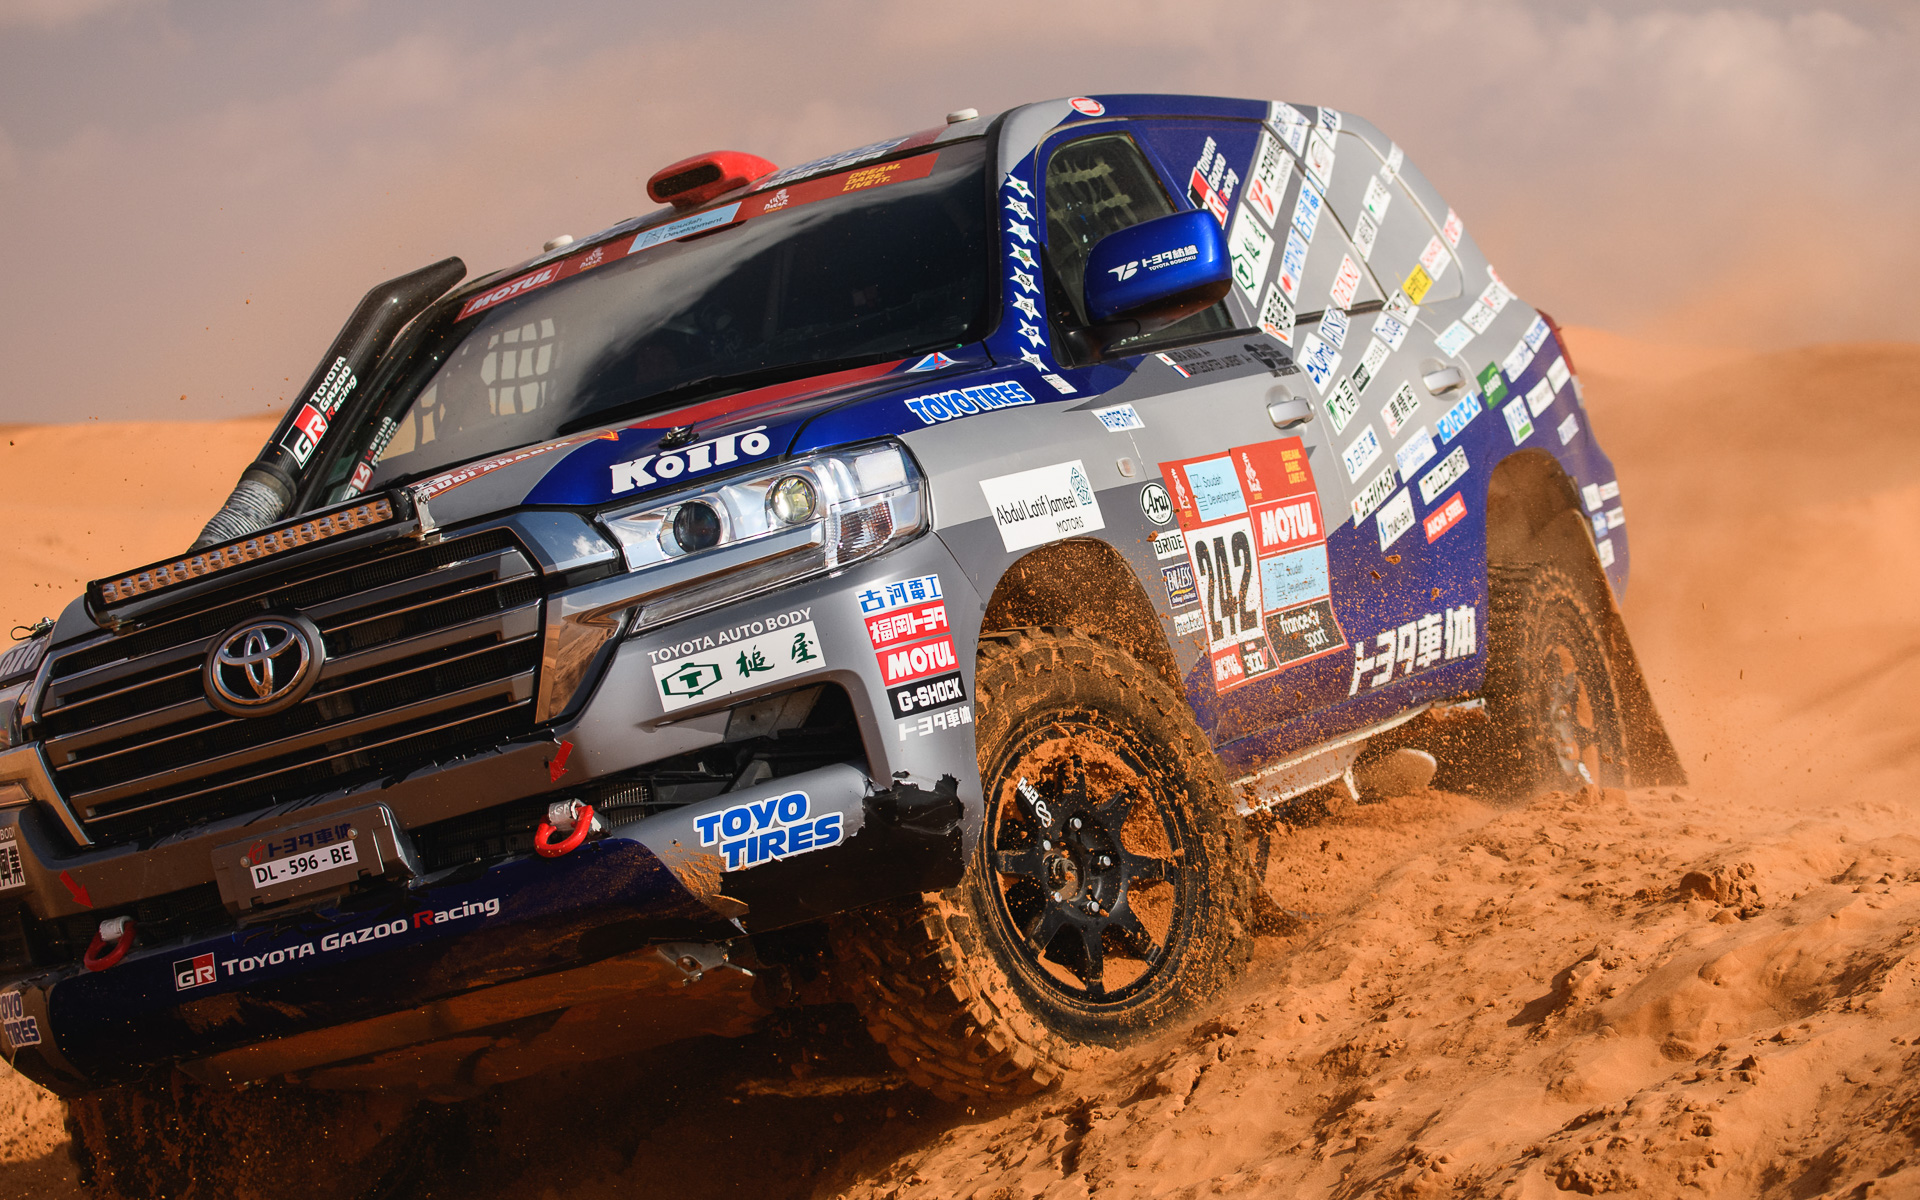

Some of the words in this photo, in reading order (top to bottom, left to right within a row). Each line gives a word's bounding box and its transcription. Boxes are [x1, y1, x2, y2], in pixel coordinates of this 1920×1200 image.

[1208, 153, 1226, 192] GAZOO
[663, 217, 723, 239] Development
[466, 269, 553, 313] MOTUL
[1333, 257, 1359, 310] DENSO
[308, 355, 346, 403] TOYOTA
[319, 365, 352, 412] GAZOO
[325, 375, 357, 421] Racing
[904, 388, 965, 424] TOYO
[963, 381, 1035, 411] TIRES
[293, 414, 326, 463] GR
[1201, 474, 1224, 488] Soudah
[1207, 490, 1242, 506] Development
[996, 498, 1027, 526] Abdul
[1026, 494, 1048, 519] Latif
[1047, 488, 1078, 517] Jameel
[1146, 489, 1170, 515] Arai
[1056, 516, 1085, 534] MOTORS
[1154, 534, 1185, 555] BRIDE
[1260, 502, 1317, 547] MOTUL
[1426, 512, 1447, 538] AICHI
[858, 575, 943, 613] 古河電工
[1194, 531, 1258, 642] 242
[648, 636, 716, 664] TOYOTA
[717, 621, 765, 646] AUTO
[767, 606, 813, 631] BODY
[869, 605, 948, 645] 福岡トヨタ
[1303, 625, 1330, 653] sport
[886, 640, 956, 681] MOTUL
[897, 677, 963, 712] G-SHOCK
[898, 705, 972, 741] トヨタ車体
[695, 792, 808, 846] TOYO
[721, 813, 843, 870] TIRES
[177, 965, 215, 988] GR
[222, 942, 315, 976] TOYOTA
[321, 918, 408, 952] GAZOO
[413, 897, 500, 929] Racing
